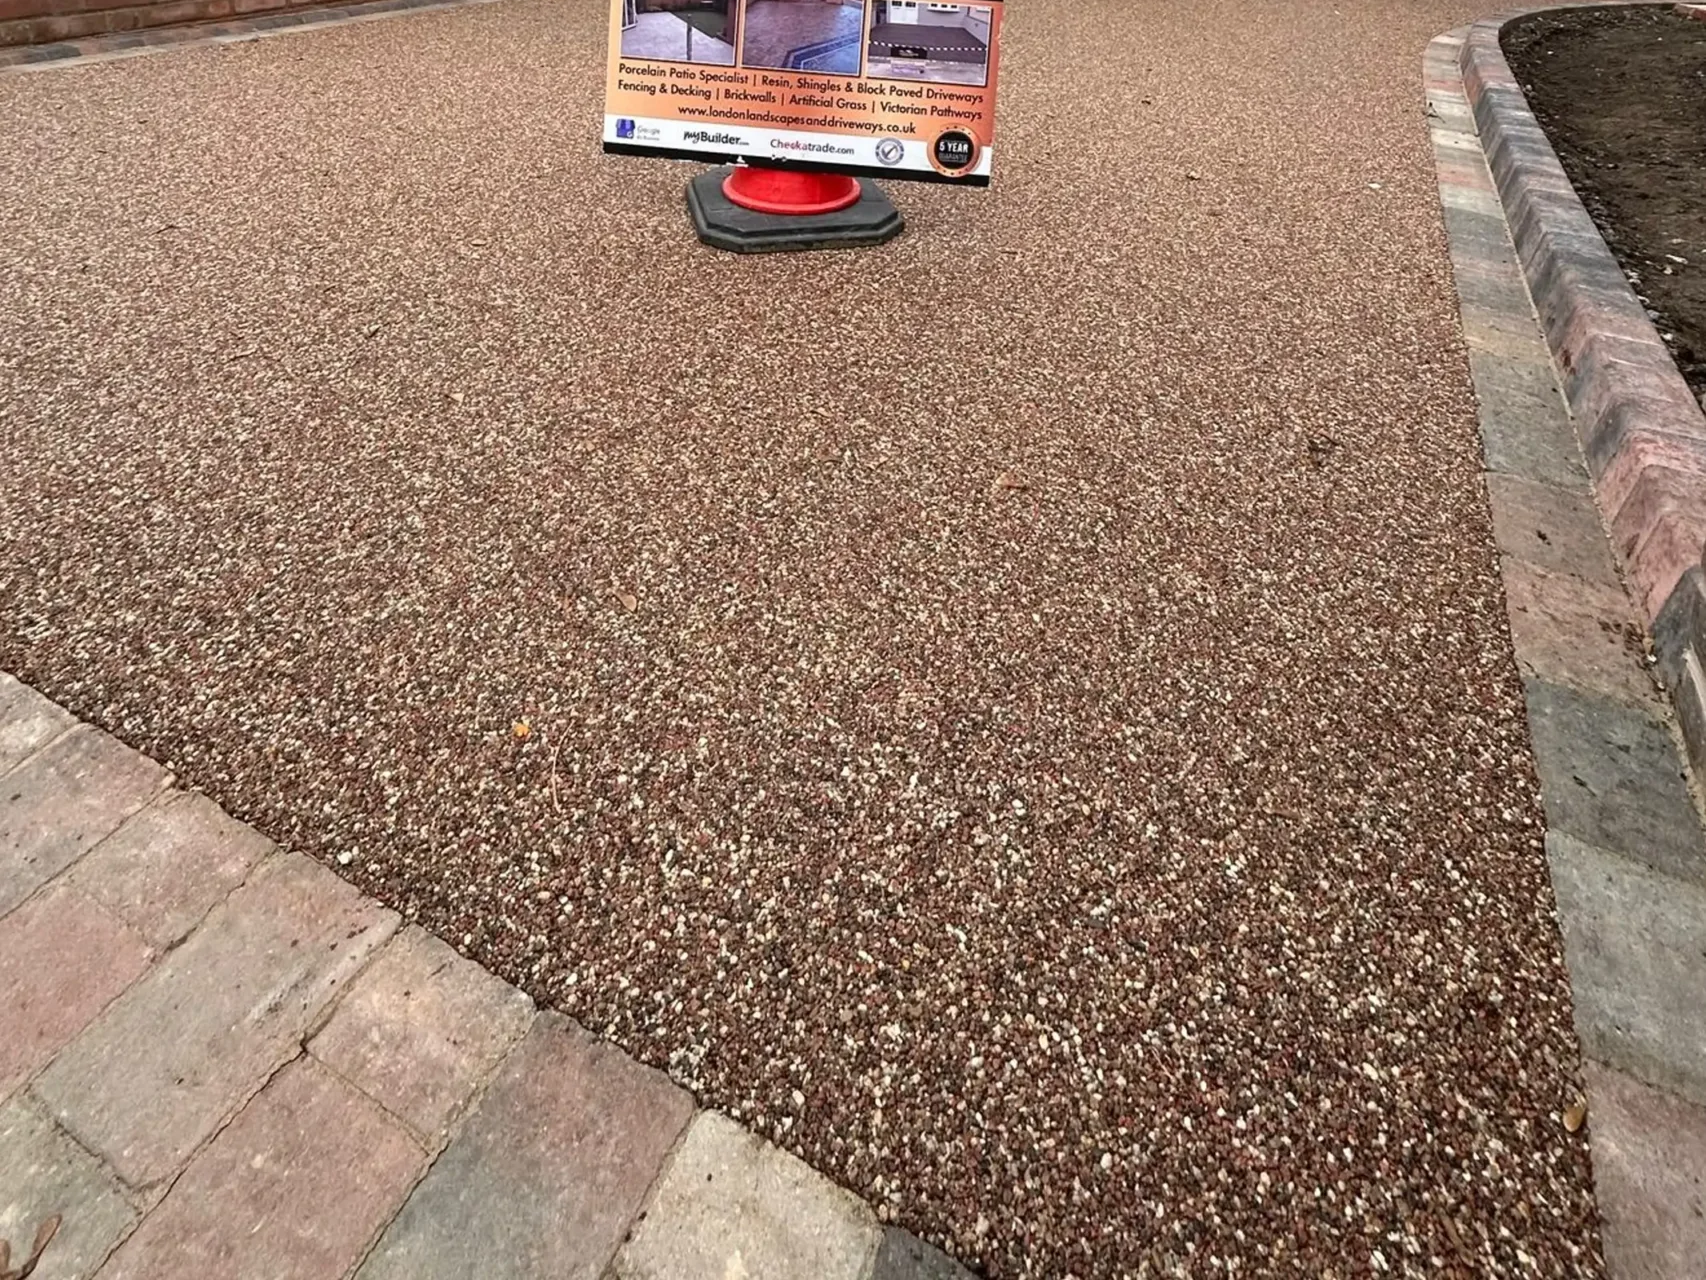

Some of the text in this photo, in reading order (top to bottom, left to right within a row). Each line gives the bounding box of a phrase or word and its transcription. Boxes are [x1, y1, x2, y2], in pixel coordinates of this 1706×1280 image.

[618, 63, 667, 77] Porcelain
[669, 67, 696, 80] Patio
[699, 70, 749, 85] Specialist
[761, 76, 793, 90] Resin,
[796, 78, 841, 93] Shingles
[844, 82, 854, 93] &
[857, 83, 886, 96] Block
[889, 86, 923, 98] Paved
[926, 88, 984, 104] Driveways
[617, 80, 657, 96] Fencing
[658, 83, 668, 94] &
[670, 84, 712, 100] Decking
[724, 89, 777, 104] Brickwalls
[789, 94, 834, 109] Artificial
[836, 98, 867, 111] Grass
[880, 101, 928, 116] Victorian
[930, 105, 983, 121] Pathways
[678, 106, 917, 135] www.londonlandscapesanddriveways.co.uk
[769, 138, 855, 155] Checkatrade.com
[947, 142, 969, 153] YEAR
